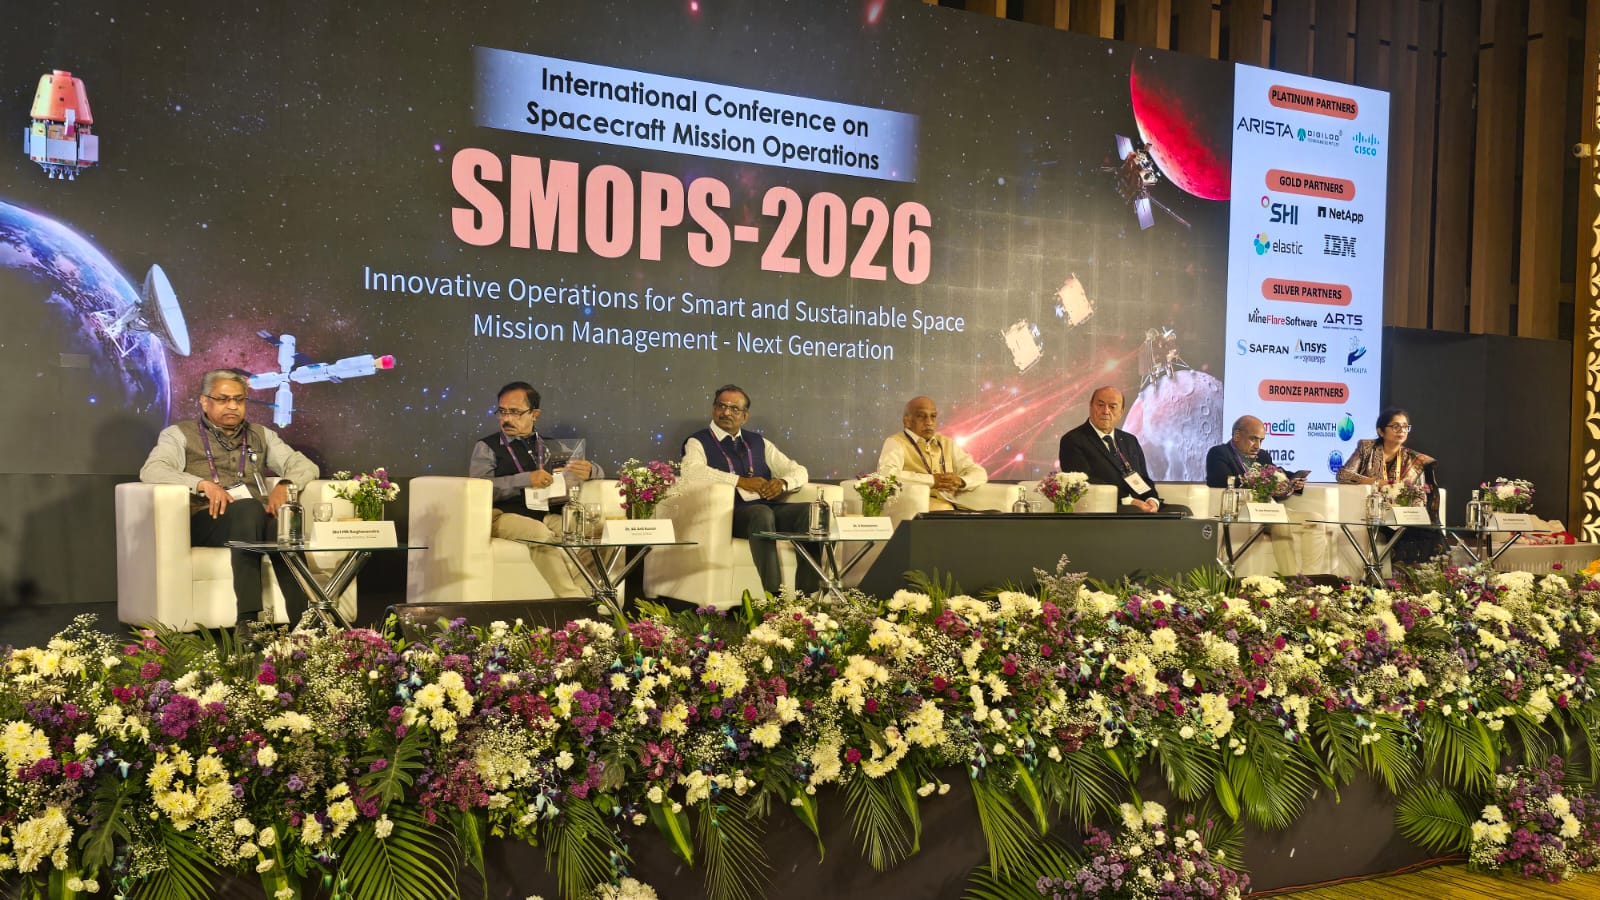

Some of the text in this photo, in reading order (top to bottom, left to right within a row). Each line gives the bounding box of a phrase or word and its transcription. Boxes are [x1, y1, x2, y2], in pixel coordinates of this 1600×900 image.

[541, 67, 870, 138] International Conference on
[1271, 90, 1356, 114] PLATINUM PARTNERS
[526, 100, 881, 171] Spacecraft Mission Operations
[1237, 117, 1294, 139] ARISTA
[1354, 145, 1377, 157] CISCO
[1279, 176, 1344, 194] GOLD PARTNERS
[451, 147, 932, 285] SMOPS-2026
[1269, 203, 1299, 225] SHI
[1329, 207, 1364, 224] NetApp
[1272, 239, 1304, 255] elastic
[1323, 234, 1357, 257] IBM
[365, 266, 965, 335] Innovative Operations for Smart and Sustainable Space
[1273, 284, 1342, 300] SILVER PARTNERS
[1323, 312, 1363, 326] ARTS
[474, 313, 564, 343] Mission
[572, 320, 719, 353] Management
[737, 331, 784, 355] Next
[788, 335, 894, 361] Generation
[1295, 338, 1327, 354] Ansys
[1249, 343, 1290, 355] SAFRAN
[1268, 384, 1344, 398] BRONZE PARTNERS
[1307, 422, 1337, 433] ANANTH
